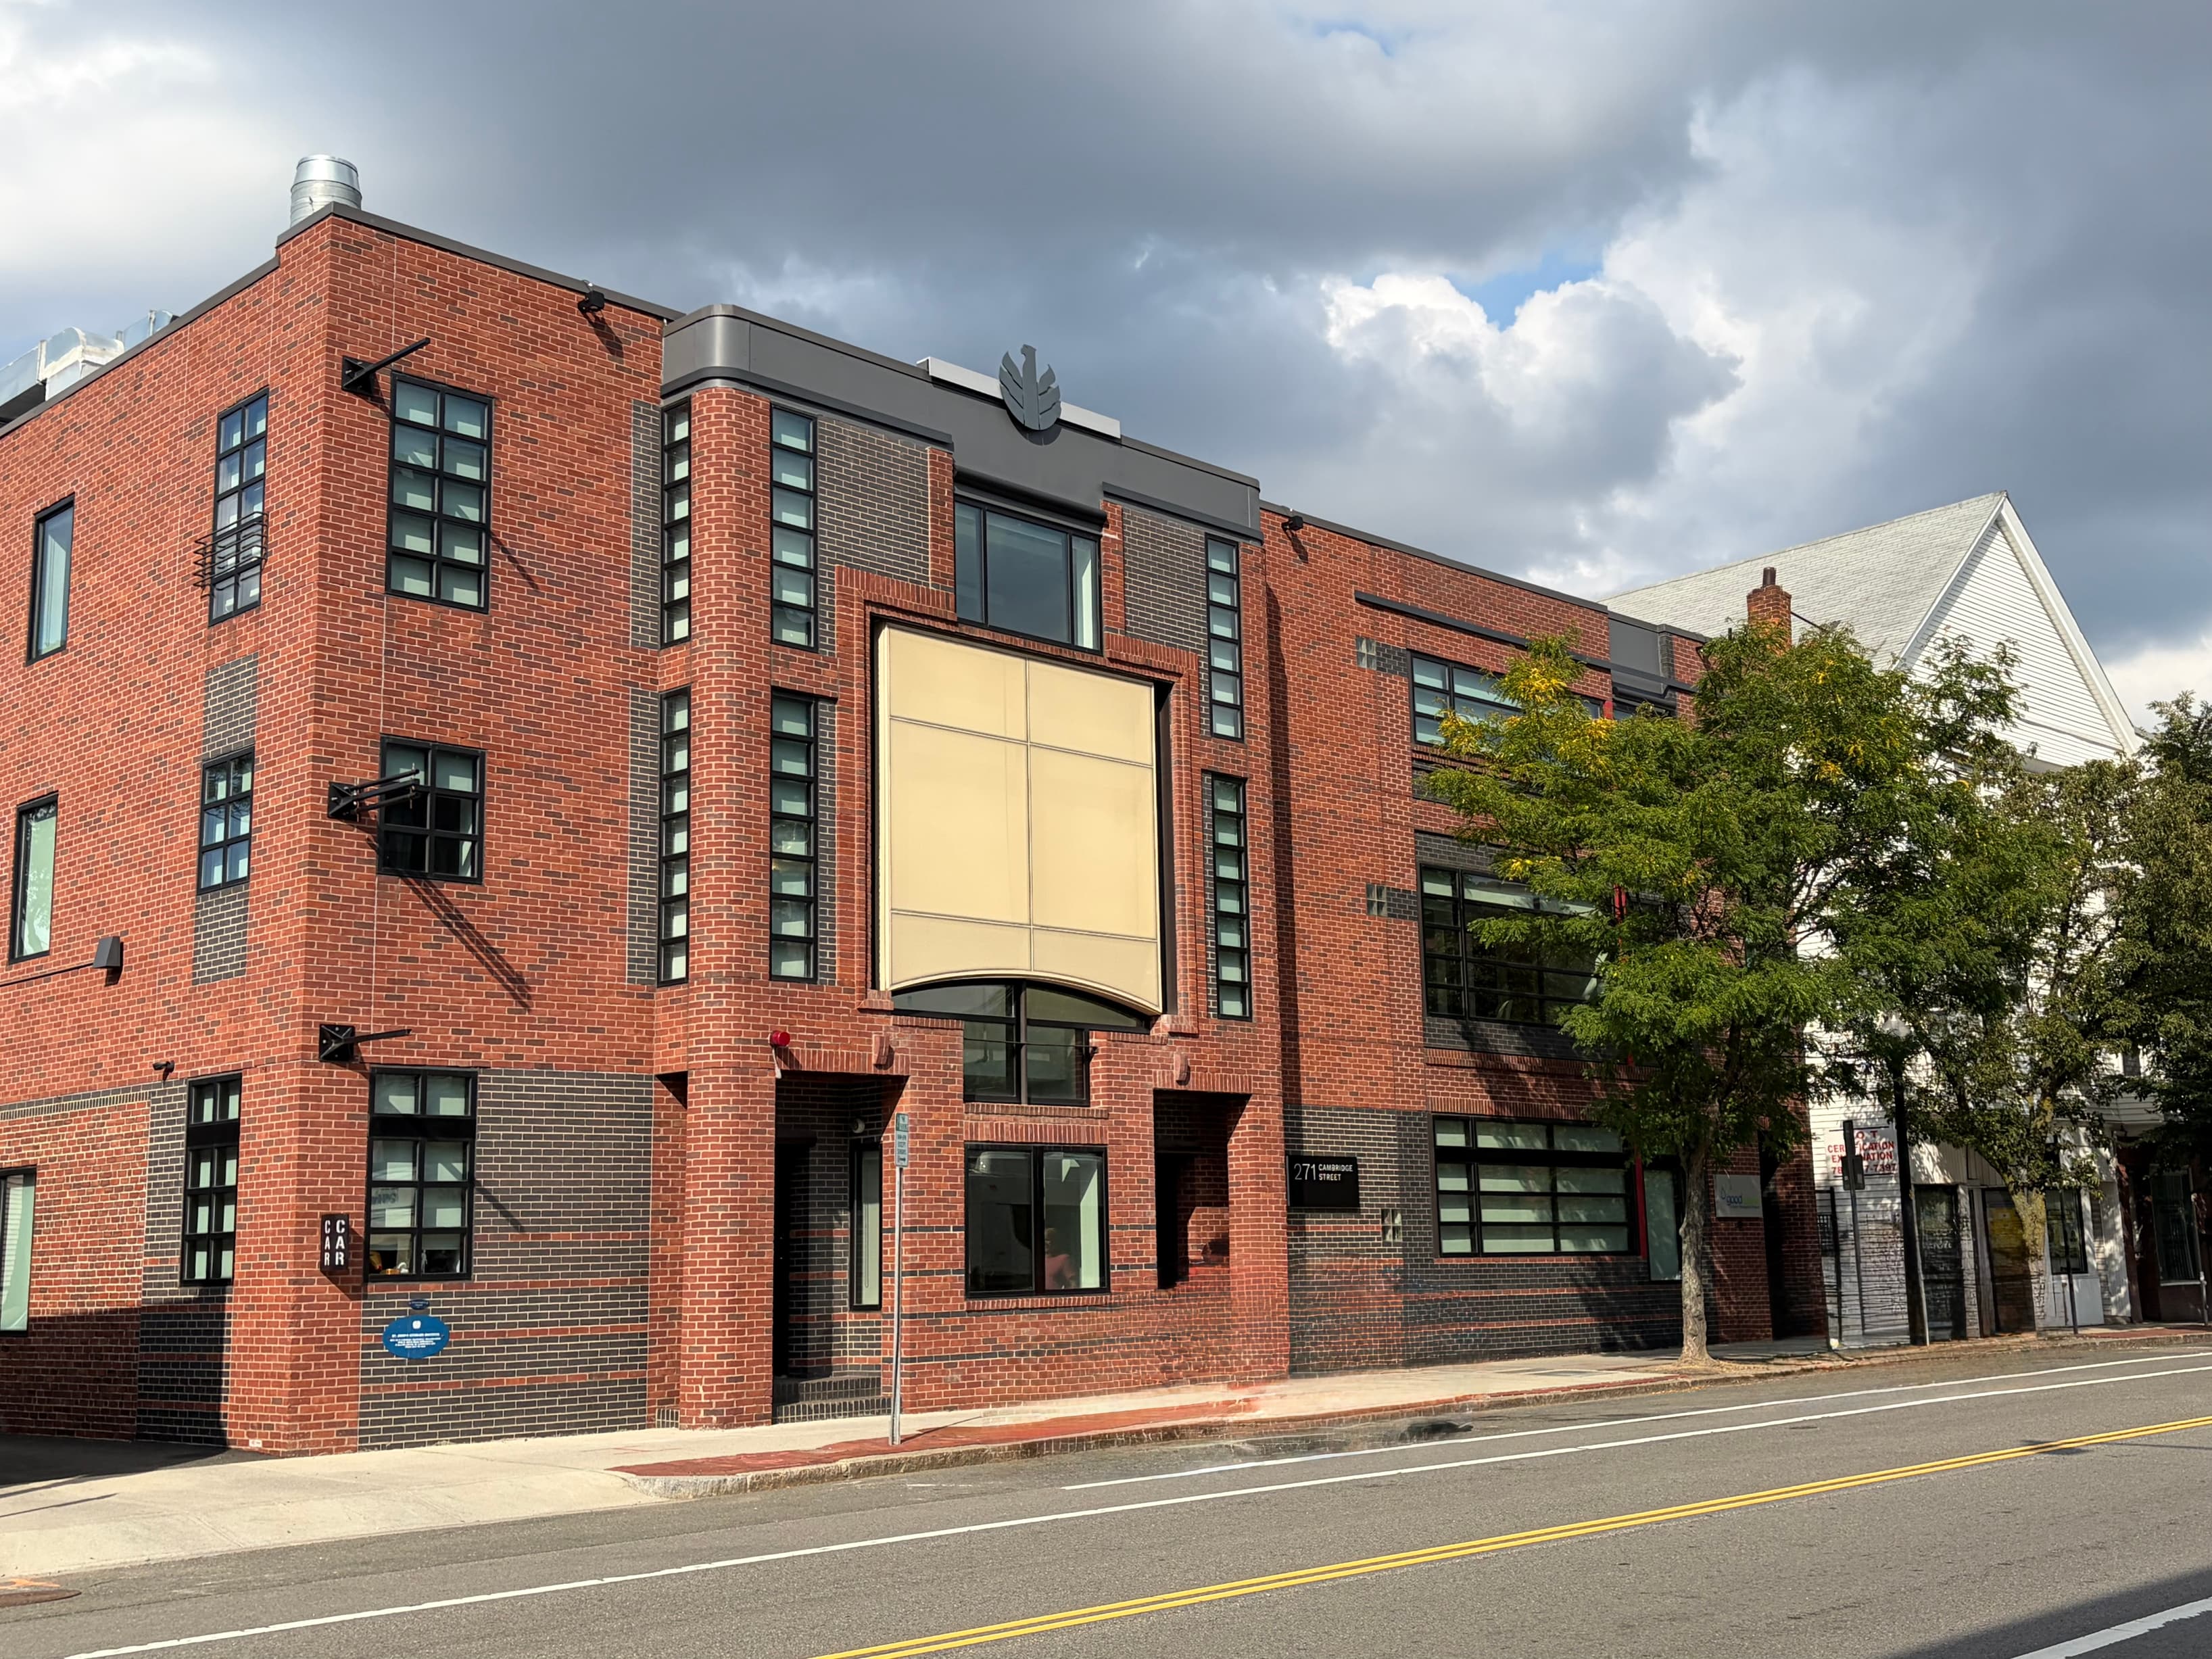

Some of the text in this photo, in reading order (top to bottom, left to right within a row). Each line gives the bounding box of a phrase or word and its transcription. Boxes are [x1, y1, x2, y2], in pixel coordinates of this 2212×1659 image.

[1827, 1140, 1895, 1153] CERFICATION
[1831, 1151, 1893, 1163] EXATION
[1294, 1163, 1353, 1180] 271 CAMBRIDGE
[1318, 1173, 1341, 1181] STREET
[335, 1220, 345, 1266] CAR
